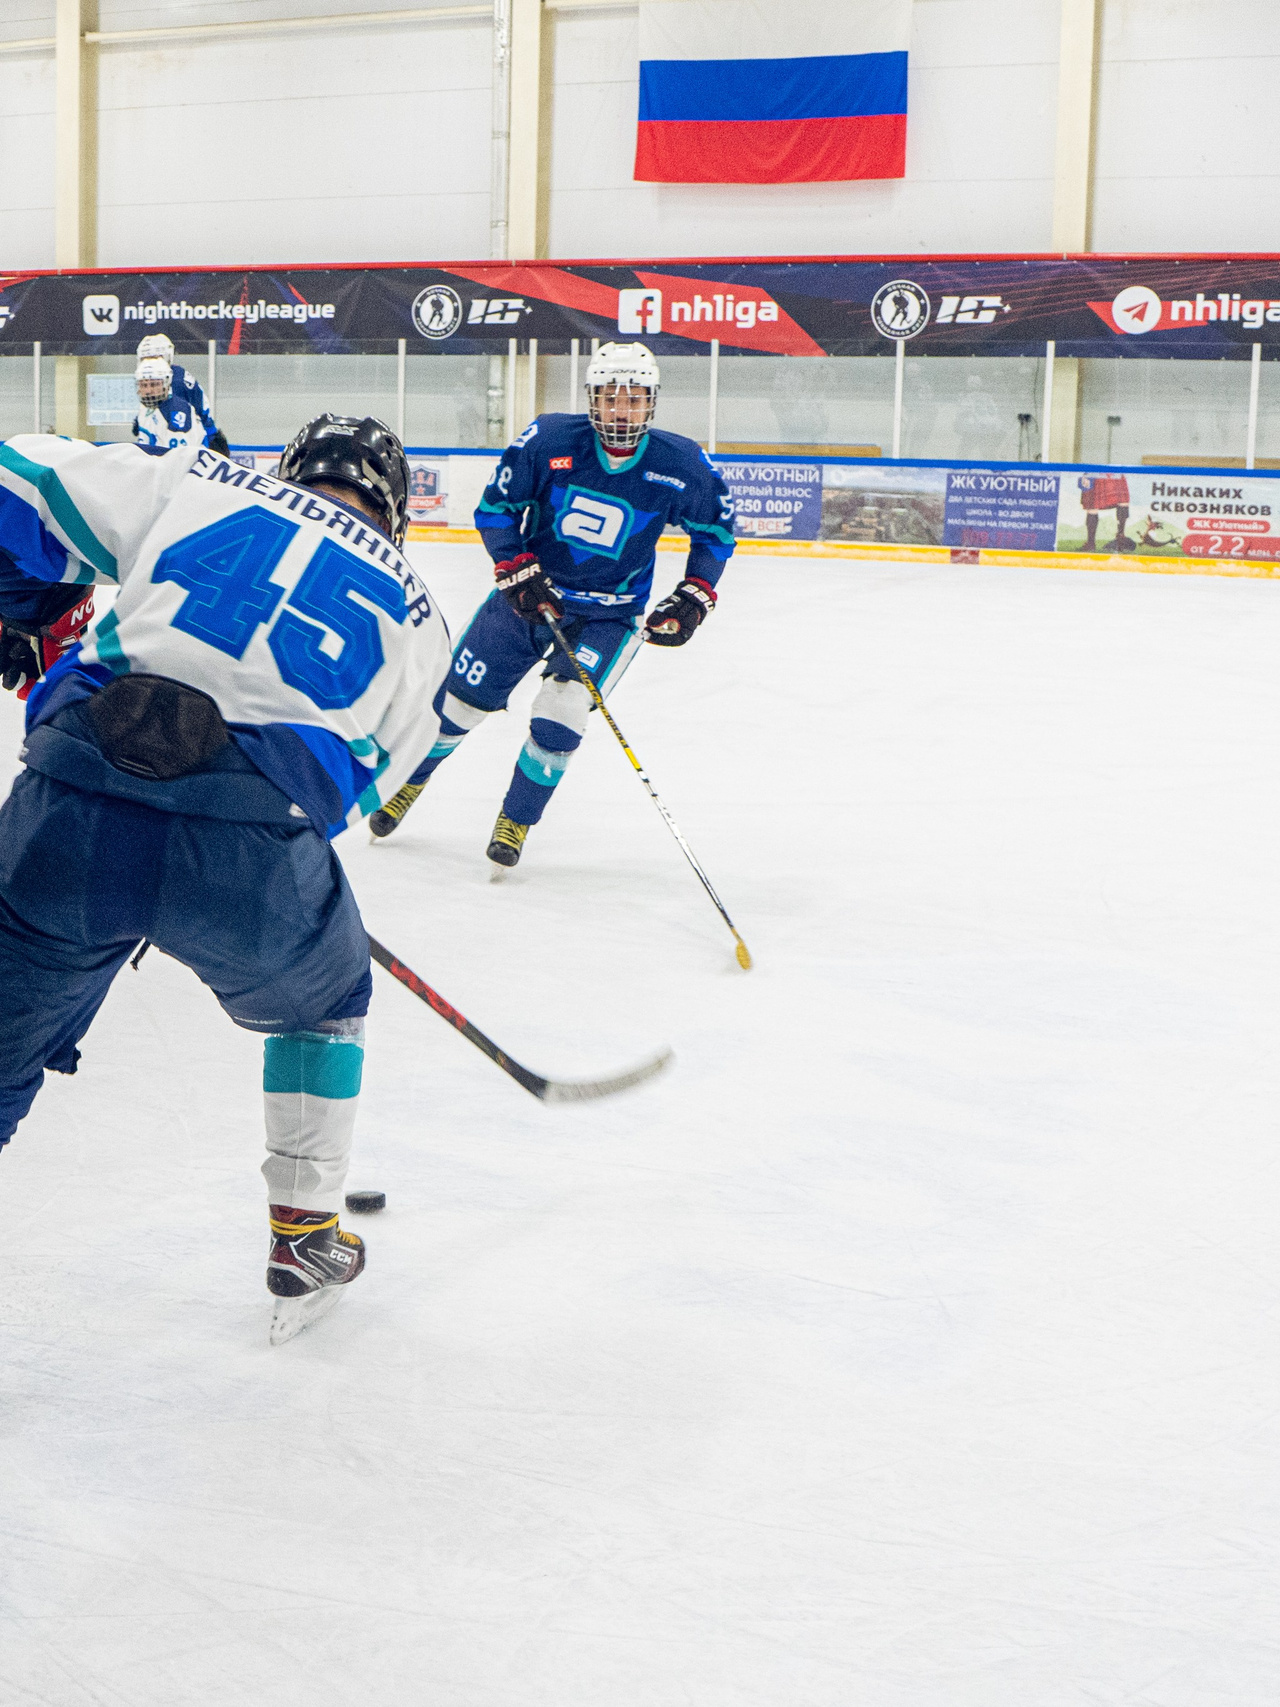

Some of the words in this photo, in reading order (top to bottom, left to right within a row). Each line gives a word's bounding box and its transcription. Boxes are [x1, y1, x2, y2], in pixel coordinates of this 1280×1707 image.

[124, 300, 336, 325] nighthockeyleague
[671, 294, 779, 329] nhliga
[721, 467, 745, 480] ЖК
[748, 467, 820, 483] УЮТНЫЙ
[729, 485, 773, 496] ПЕРВЫЙ
[775, 487, 812, 498] ВЗНОС
[951, 475, 976, 490] ЖК
[980, 475, 1056, 493] УЮТНЫЙ
[1151, 482, 1243, 499] Никаких
[735, 499, 762, 512] 250
[1193, 519, 1211, 528] ЖК
[151, 504, 408, 711] 45
[455, 648, 486, 686] 58
[329, 1249, 353, 1265] CCM
